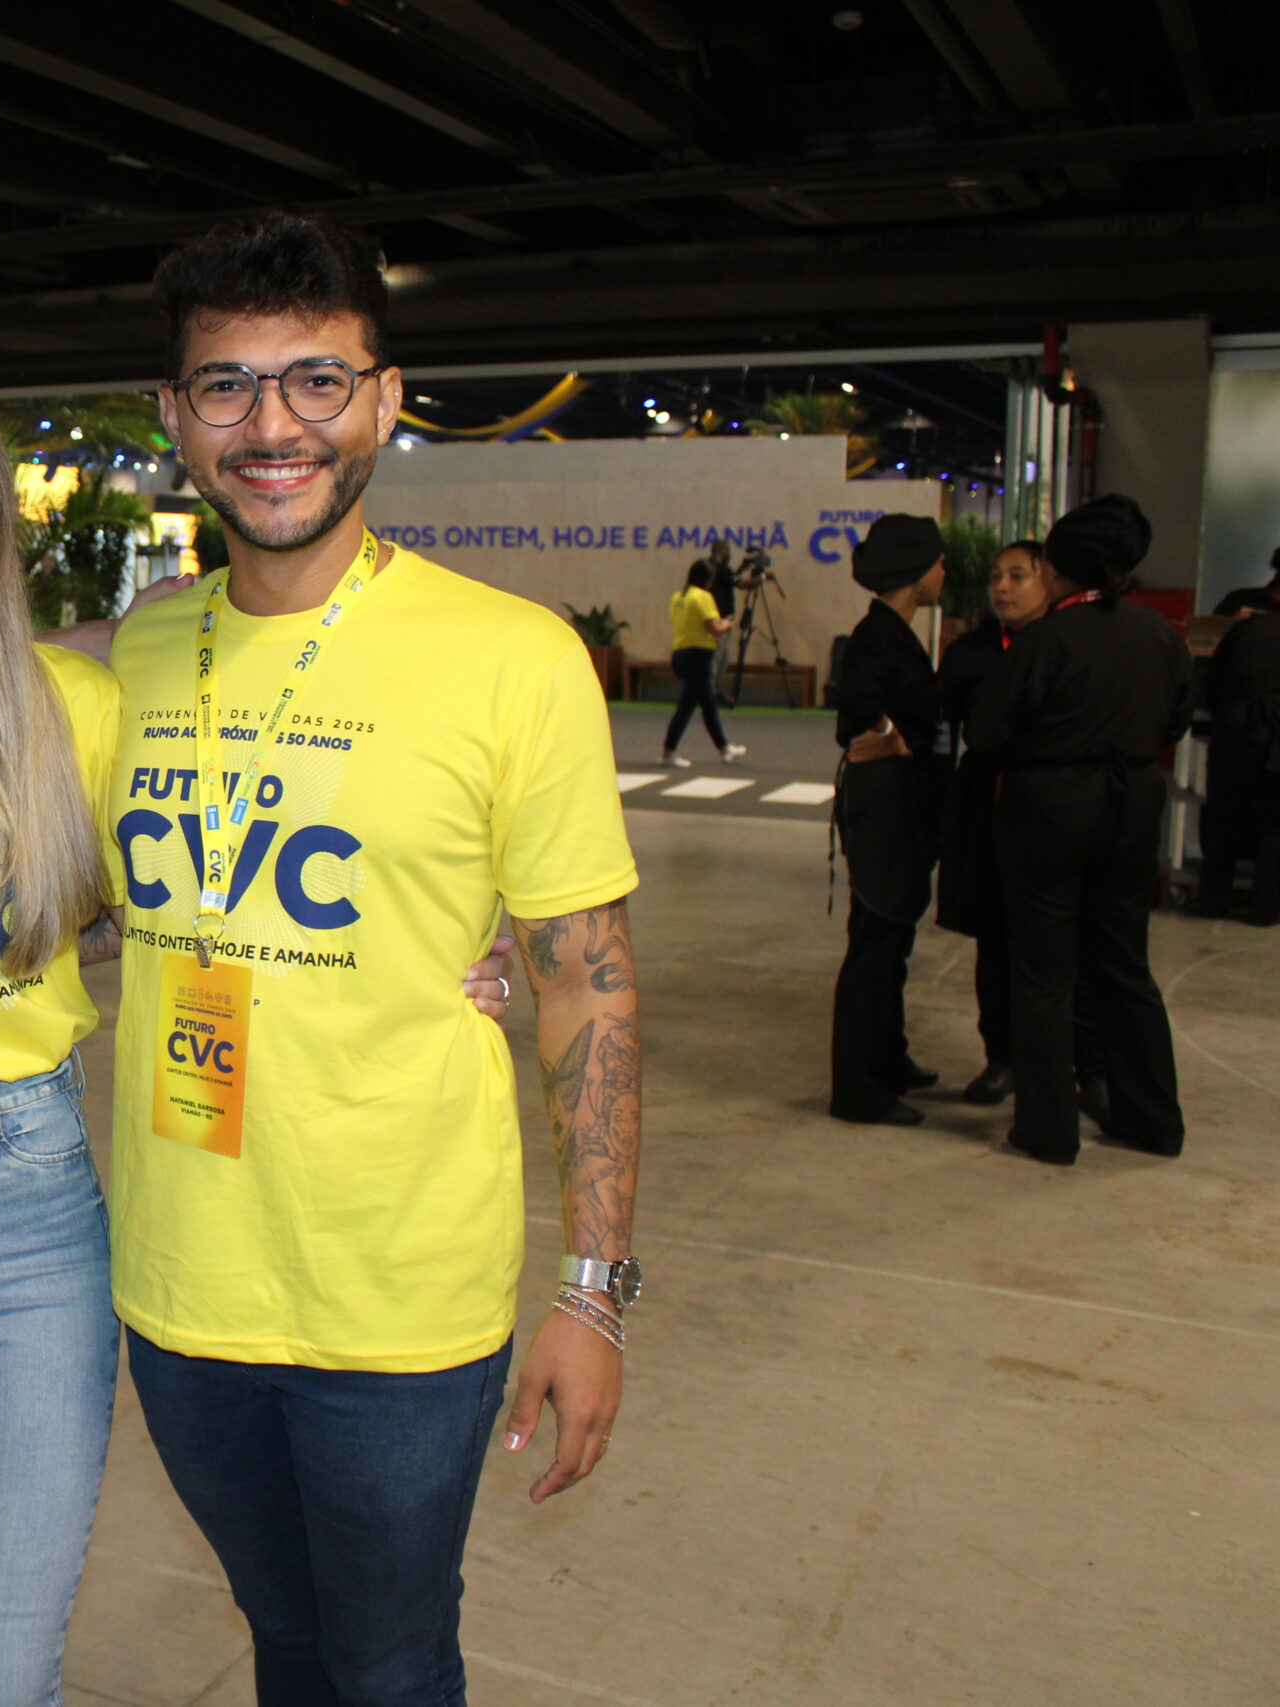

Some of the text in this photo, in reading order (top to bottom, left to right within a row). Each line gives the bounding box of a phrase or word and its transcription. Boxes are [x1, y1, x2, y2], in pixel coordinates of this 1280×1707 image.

[371, 521, 789, 551] NTOS ONTEM, HOJE E AMANHÃ
[808, 525, 862, 564] CV
[199, 648, 209, 679] CVC
[294, 639, 317, 671] CVC
[140, 709, 375, 733] CONVEN DE VDAS 2025
[143, 727, 179, 739] RUMO
[180, 727, 197, 738] AO
[286, 733, 306, 746] 50
[308, 735, 353, 751] ANOS
[129, 767, 284, 808] FUTO
[116, 809, 363, 930] CVC
[209, 849, 222, 883] CVC
[212, 940, 256, 959] HOJE
[259, 946, 271, 961] E
[273, 948, 358, 969] AMANHÃ
[175, 1016, 216, 1036] FUTURO
[167, 1031, 235, 1075] CVC
